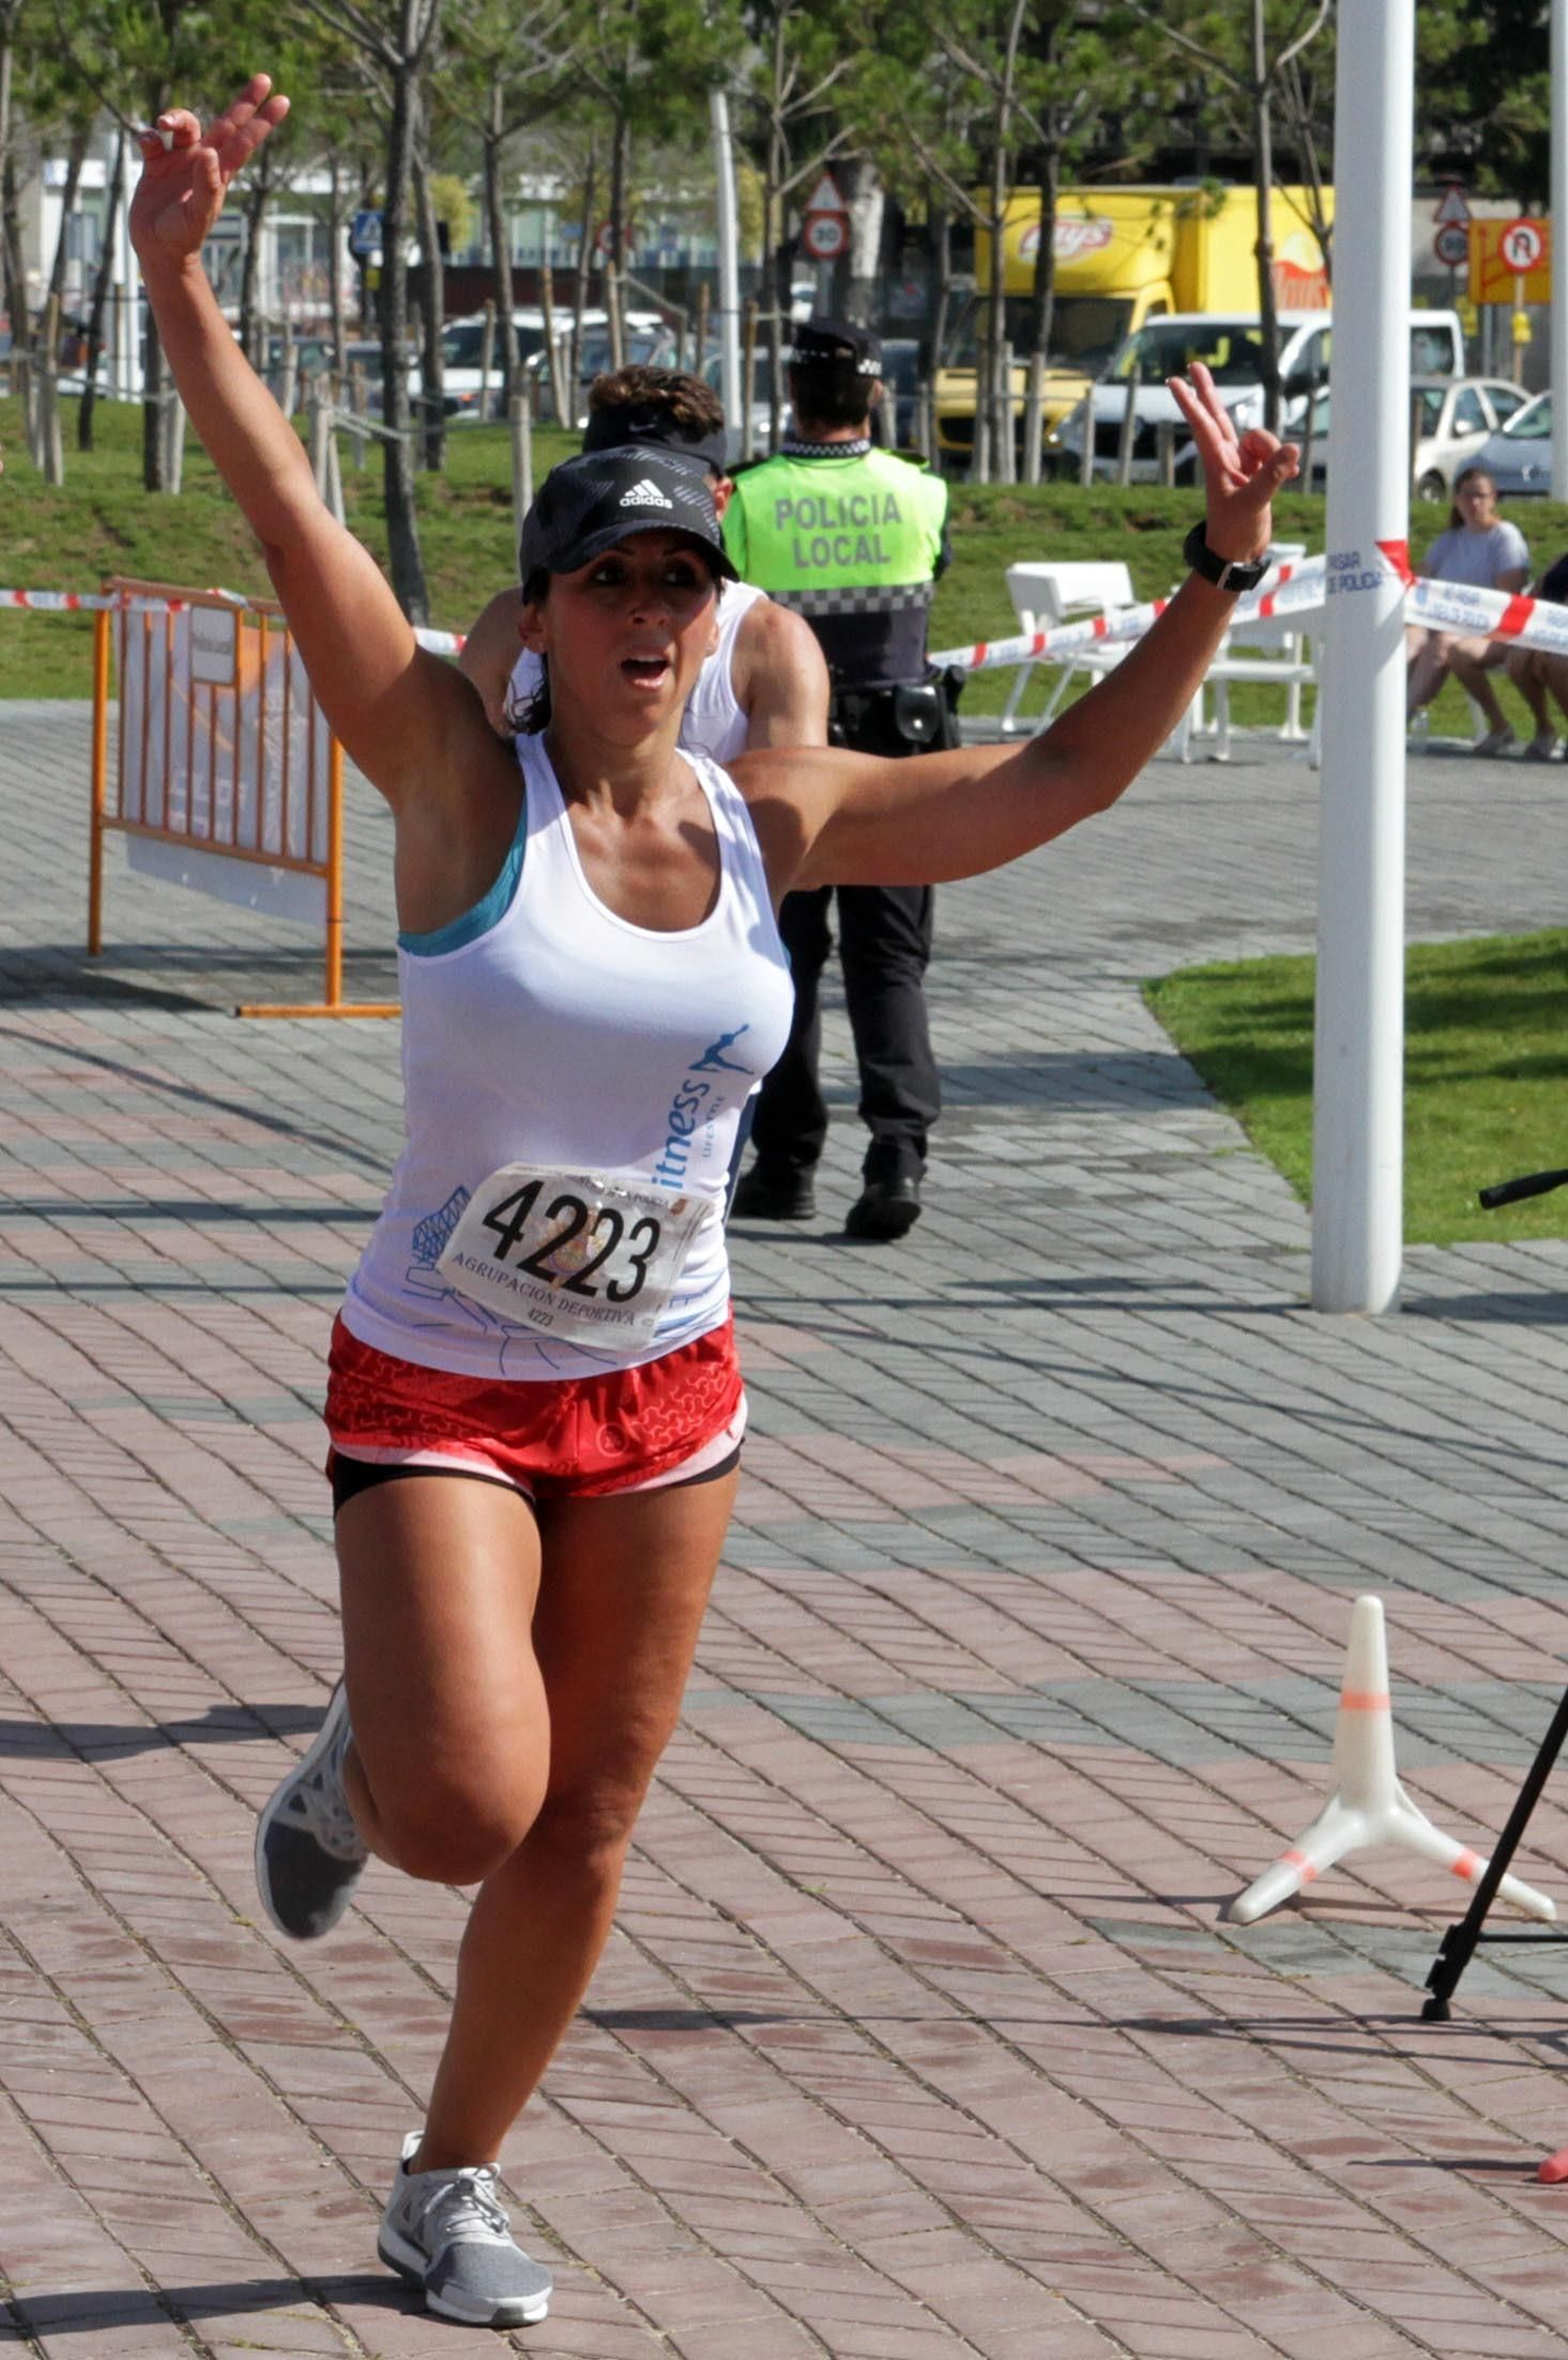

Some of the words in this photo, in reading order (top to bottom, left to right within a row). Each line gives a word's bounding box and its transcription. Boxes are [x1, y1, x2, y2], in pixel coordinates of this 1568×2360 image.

[619, 494, 673, 510] adidas
[774, 493, 902, 531] POLICIA
[793, 533, 892, 568] LOCAL
[652, 1079, 710, 1189] itness
[482, 1179, 661, 1303] 4223
[528, 1308, 555, 1327] 4223
[558, 1299, 635, 1326] DEPORTIVA
